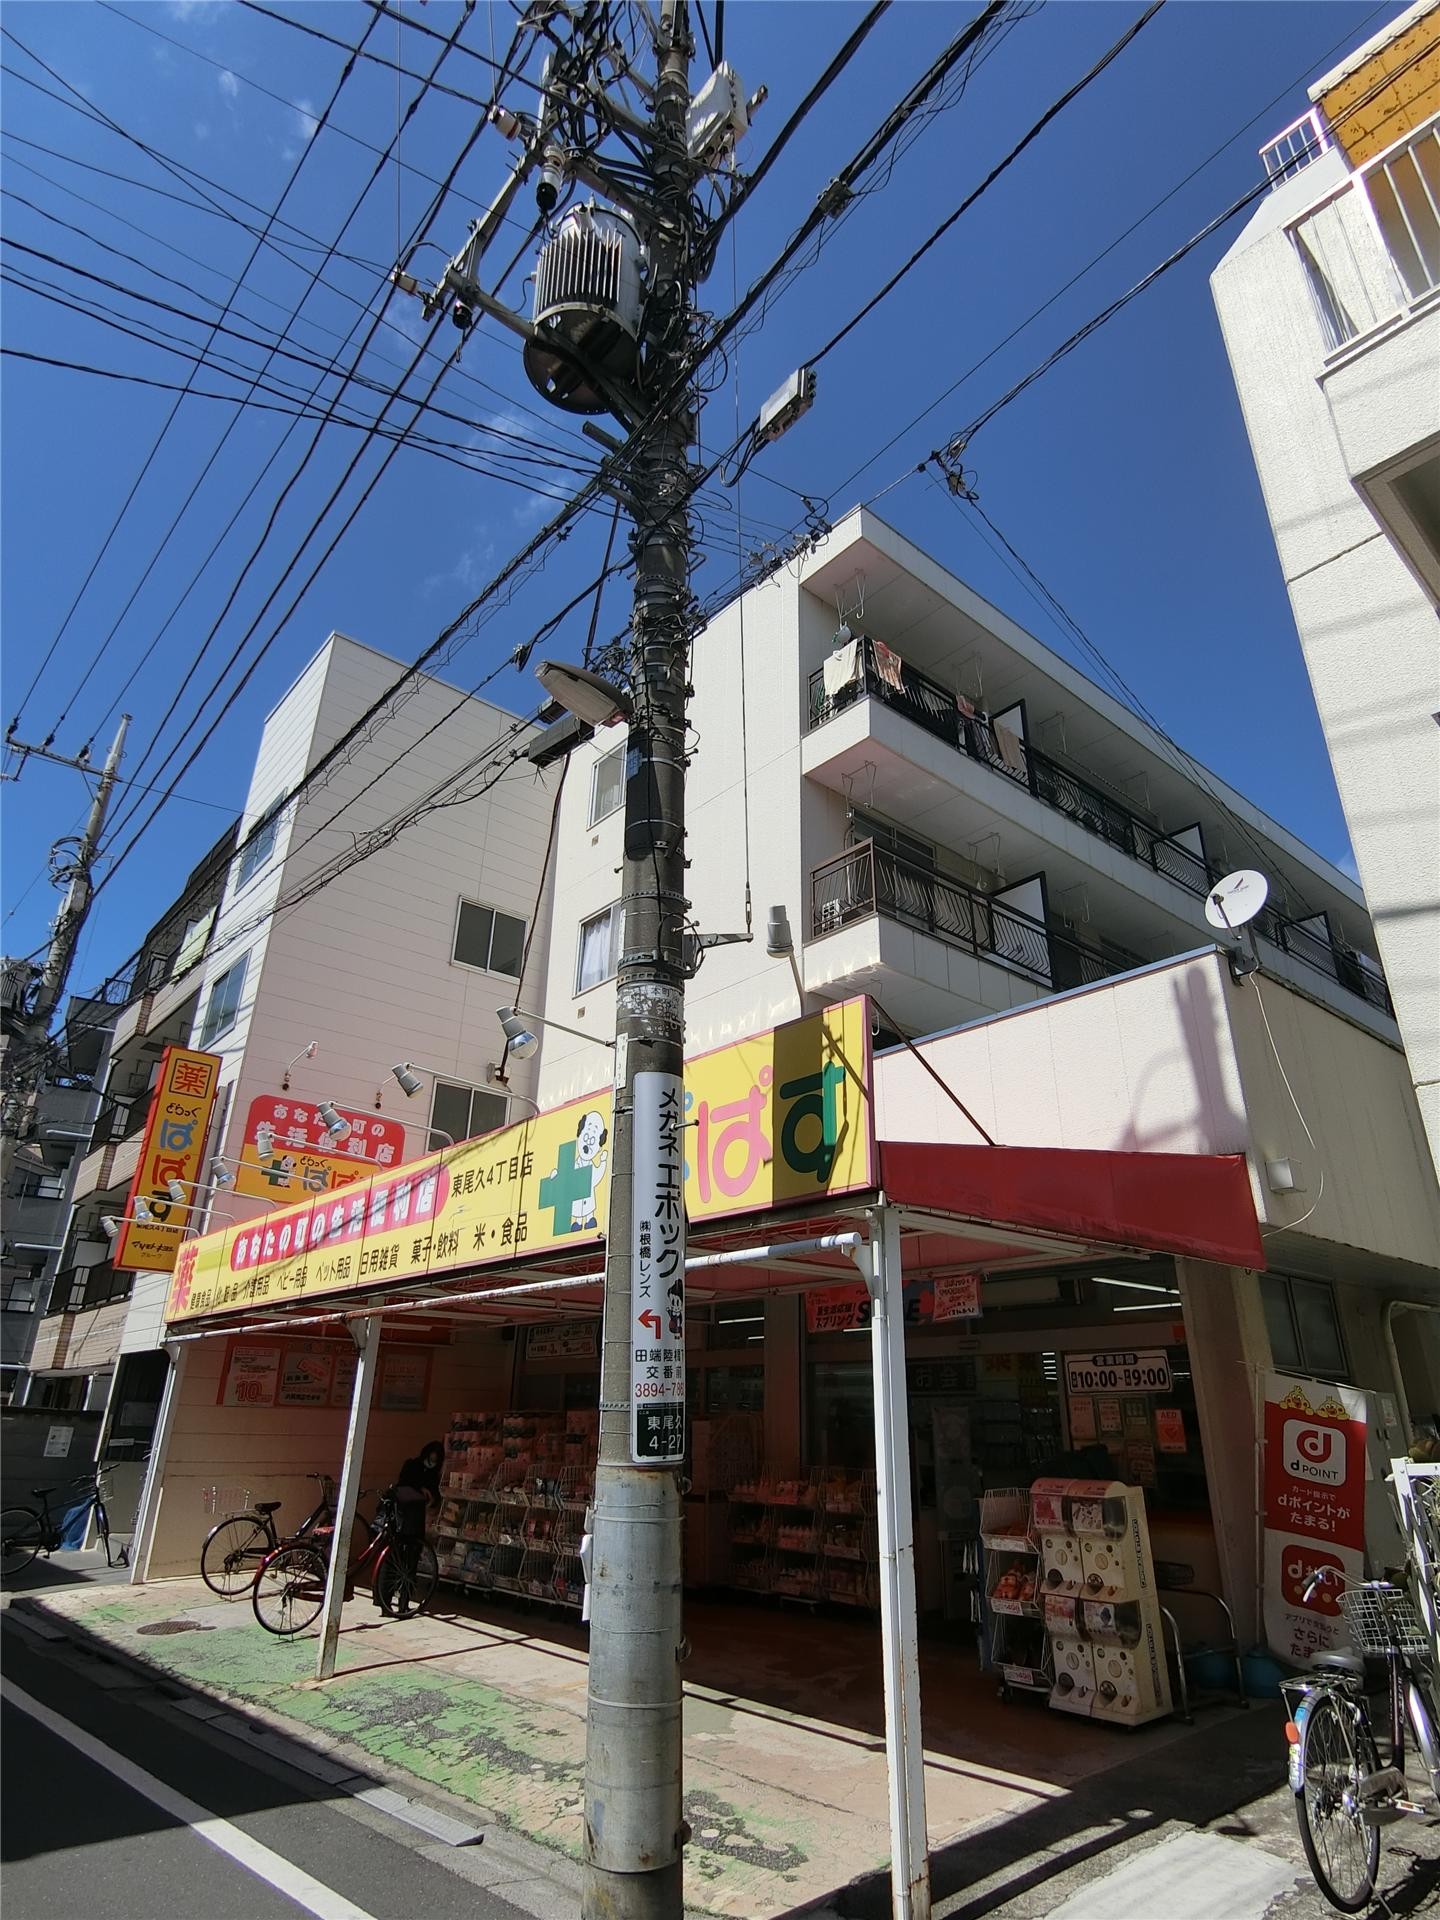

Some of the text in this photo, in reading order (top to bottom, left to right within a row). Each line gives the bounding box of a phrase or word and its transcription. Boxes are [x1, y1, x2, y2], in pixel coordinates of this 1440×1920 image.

[174, 1062, 208, 1096] 薬
[273, 1103, 386, 1138] あなた町の
[683, 1061, 847, 1203] ぱす
[303, 1166, 364, 1192] ぱぱ
[451, 1152, 535, 1198] 東尾久4丁目店
[655, 1087, 681, 1279] メガネ エポック
[236, 1175, 436, 1264] あなたの町の生活便利店
[316, 1255, 351, 1283] ペット用品
[359, 1243, 400, 1275] 日用雑貨
[647, 1415, 682, 1430] 東尾久
[1290, 1459, 1339, 1480] d POINT
[1277, 1493, 1351, 1519] dポイントが
[1290, 1511, 1337, 1532] たまる!
[1290, 1643, 1322, 1659] たま
[1293, 1628, 1330, 1649] さらに
